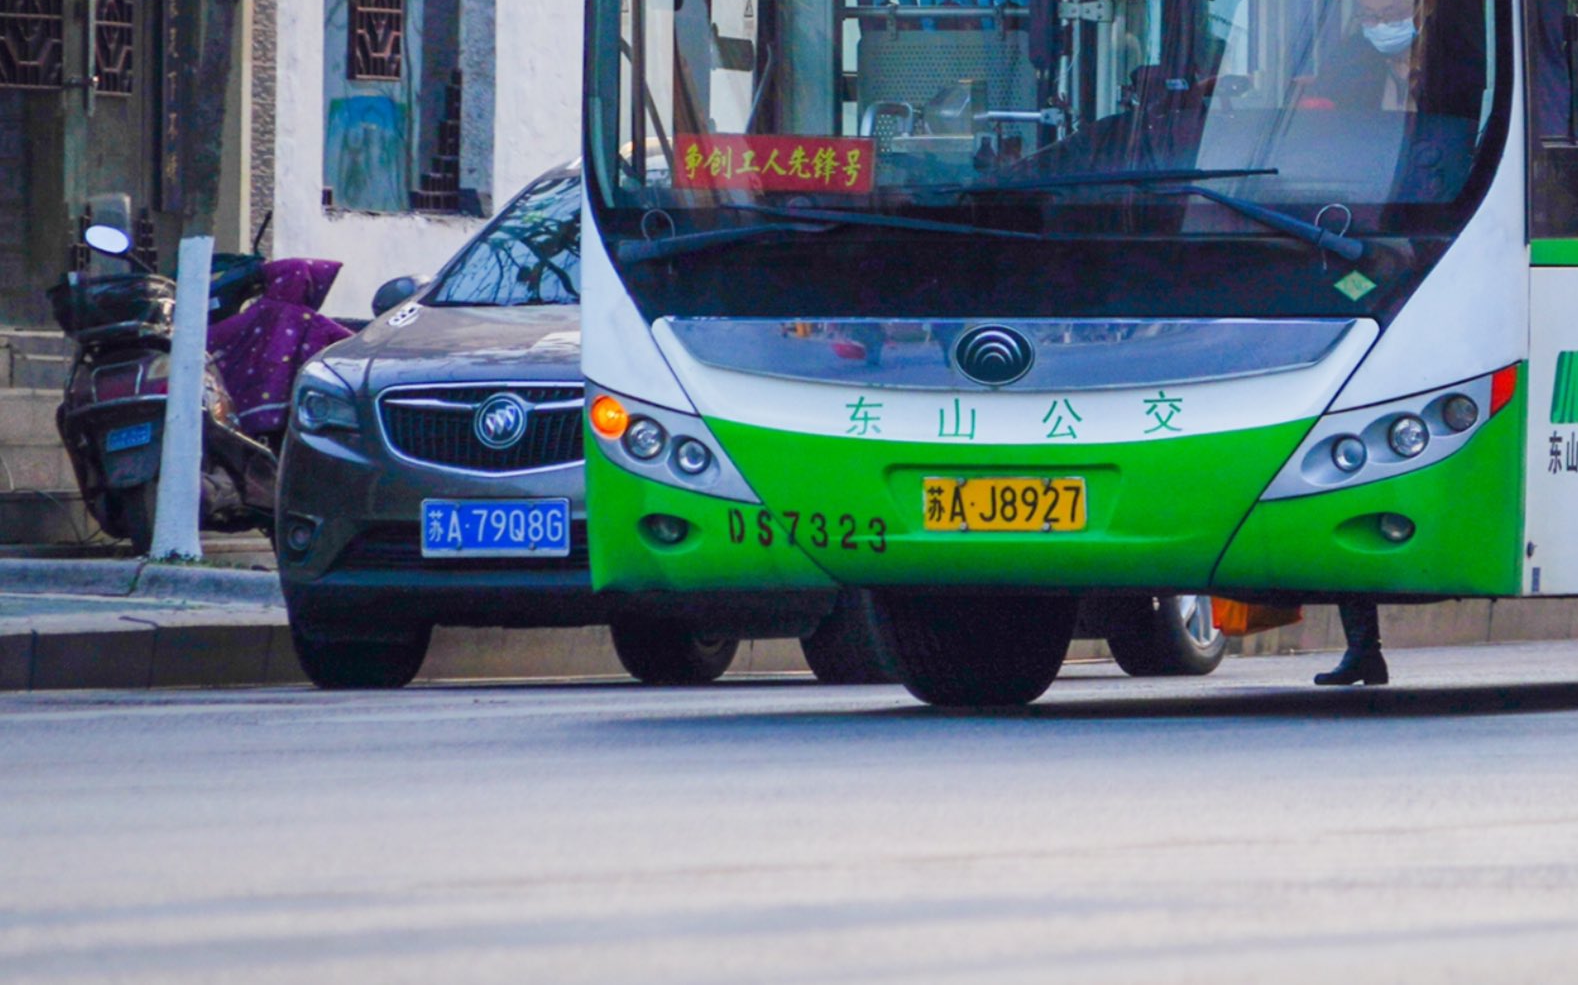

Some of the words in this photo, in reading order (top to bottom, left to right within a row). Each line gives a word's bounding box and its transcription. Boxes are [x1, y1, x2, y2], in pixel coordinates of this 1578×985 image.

[684, 142, 861, 187] 争创工人先锋号
[845, 390, 1184, 440] 东山公交
[727, 508, 887, 554] DS7323
